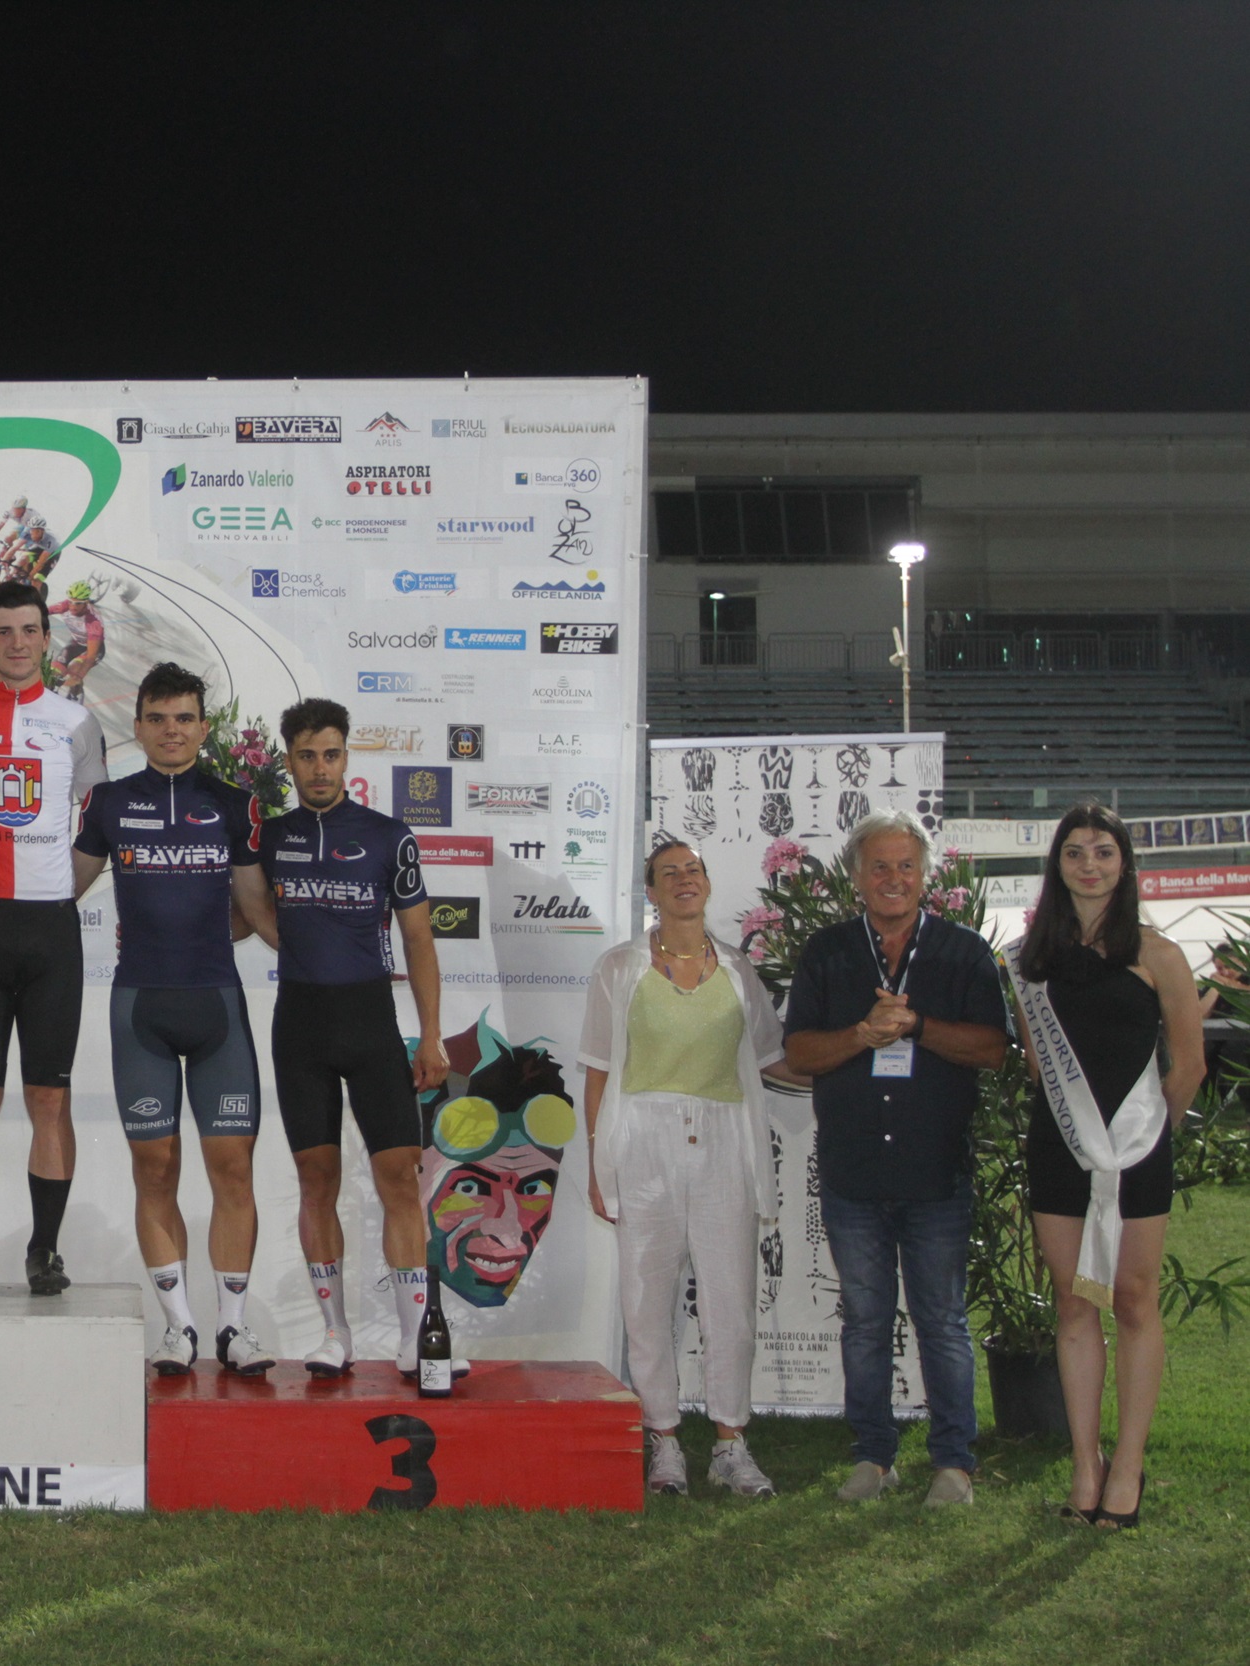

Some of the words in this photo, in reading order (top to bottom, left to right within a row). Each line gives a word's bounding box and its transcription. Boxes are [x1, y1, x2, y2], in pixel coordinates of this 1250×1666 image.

[144, 422, 177, 435] Ciasa
[180, 422, 193, 435] de
[196, 422, 230, 437] Gahja
[452, 419, 486, 430] FRIUL
[452, 430, 487, 438] INTAGLI
[375, 438, 402, 447] APLIS
[191, 470, 244, 487] Zanardo
[248, 469, 294, 487] Valerio
[345, 465, 431, 478] ASPIRATORI
[535, 473, 563, 482] Banca
[570, 469, 597, 482] 360
[437, 516, 534, 533] starwood
[281, 572, 312, 584] Daas
[313, 574, 324, 587] &
[281, 586, 346, 598] Chemicals
[512, 590, 602, 600] OFFICELANDIA
[348, 631, 438, 649] Salvador
[468, 633, 522, 644] RENNER
[557, 640, 602, 653] BIKE
[358, 675, 412, 690] CRM
[532, 688, 592, 698] ACQUOLINA
[538, 734, 582, 746] L.A.F.
[478, 787, 538, 802] FORMA
[403, 807, 441, 815] CANTINA
[403, 816, 441, 824] PADOVAN
[944, 822, 1014, 832] ONDAZIONE
[4, 831, 57, 846] Pordenone
[944, 834, 973, 844] RIULI
[439, 848, 459, 856] della
[460, 849, 485, 857] Marca
[394, 834, 424, 899] 8
[1159, 876, 1193, 887] Banca
[1196, 873, 1224, 885] della
[513, 895, 592, 919] Volata
[490, 922, 551, 935] BATTISTELLA
[1034, 990, 1044, 1002] 6
[1040, 1005, 1081, 1083] GIORNI
[1024, 1001, 1038, 1022] DI
[1032, 1028, 1086, 1157] PORDENONE
[311, 1265, 337, 1279] ALIA
[397, 1272, 428, 1284] ITAL
[754, 1331, 774, 1340] ENDA
[776, 1332, 816, 1341] AGRICOLA
[764, 1342, 795, 1351] ANGELO
[798, 1343, 803, 1351] &
[806, 1343, 828, 1352] ANNA
[364, 1414, 437, 1512] 3
